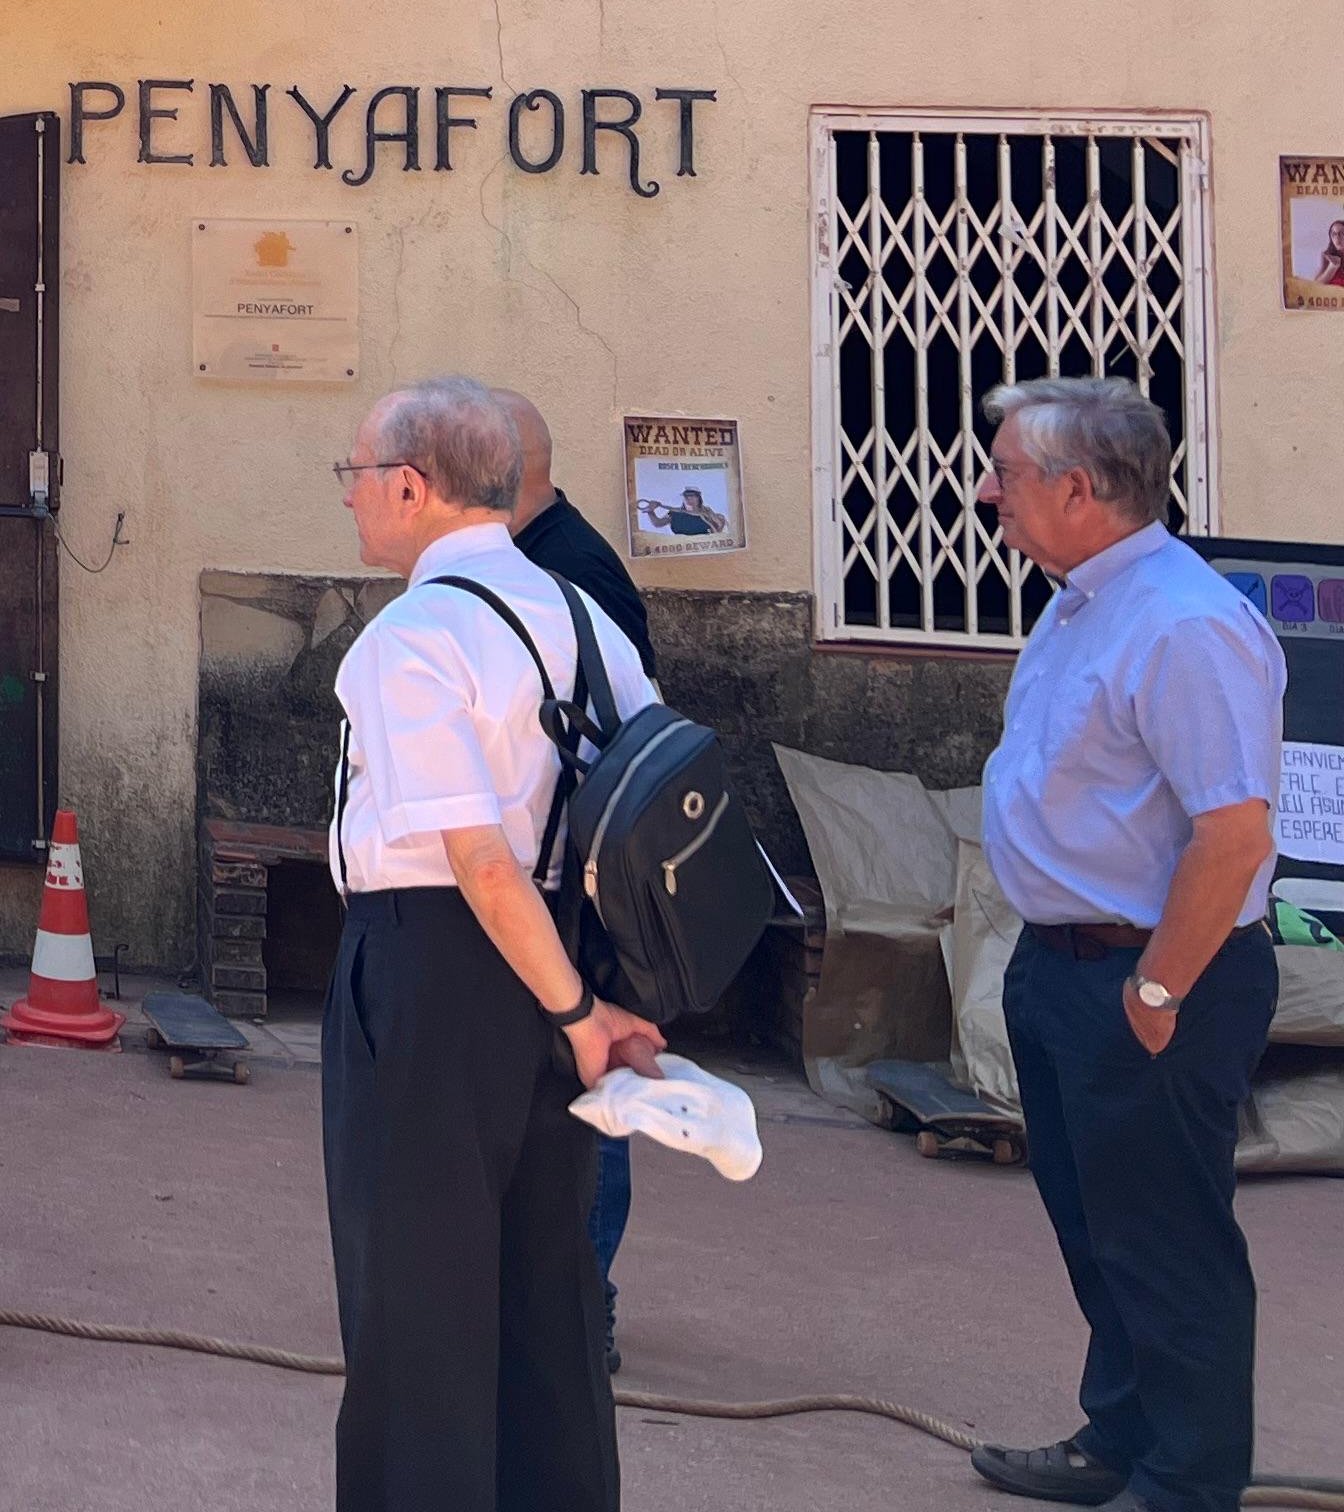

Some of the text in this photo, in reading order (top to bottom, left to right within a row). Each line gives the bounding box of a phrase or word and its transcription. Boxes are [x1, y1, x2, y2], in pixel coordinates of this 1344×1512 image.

[67, 79, 717, 198] PENYAFORT
[1297, 185, 1328, 196] DEAD
[237, 302, 314, 316] PENYAFORT
[627, 423, 734, 446] WANTED
[639, 446, 724, 457] DEAD OR ALIVE
[685, 538, 734, 552] REWARD
